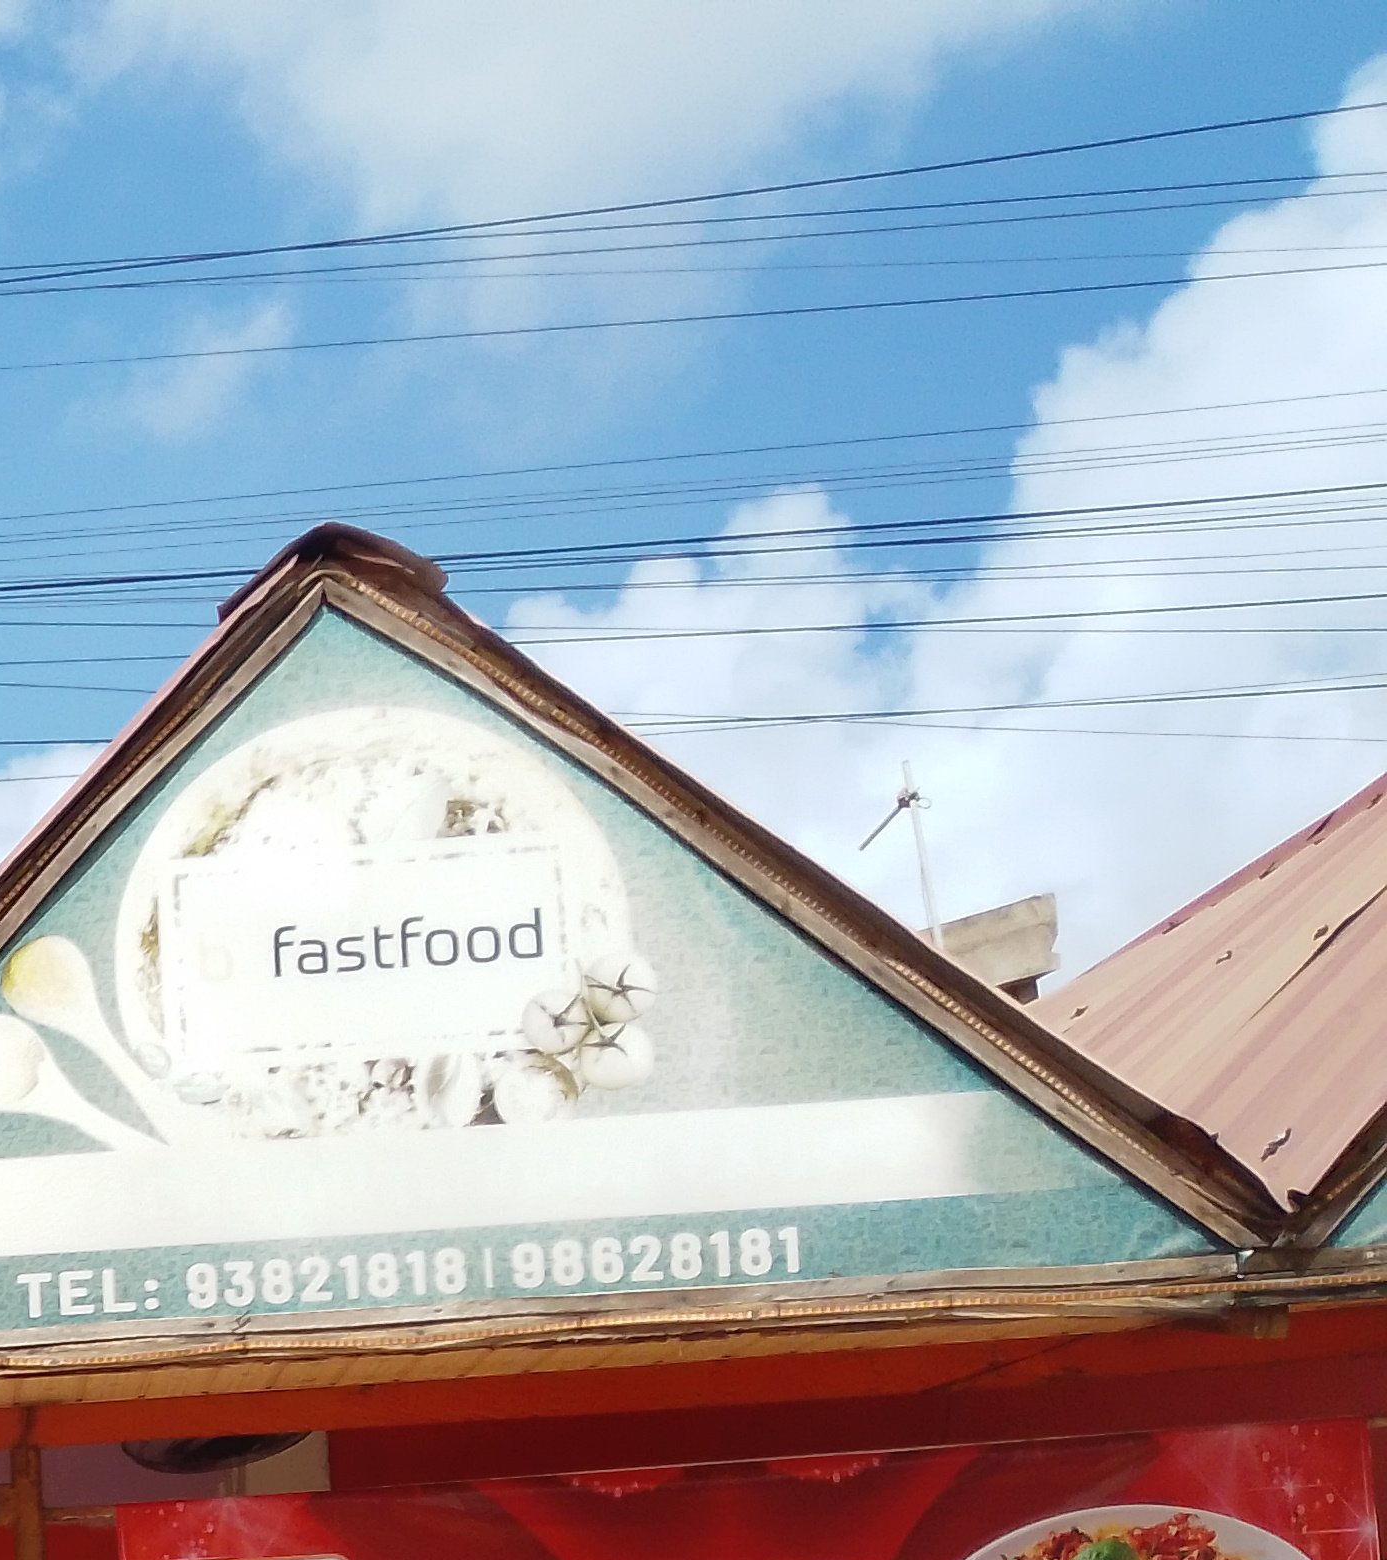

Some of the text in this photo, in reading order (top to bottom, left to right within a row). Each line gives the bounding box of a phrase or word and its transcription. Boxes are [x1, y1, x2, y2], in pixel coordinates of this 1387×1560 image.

[272, 906, 545, 979] fastfood
[17, 1225, 804, 1320] TEL: 93821818 98628181
